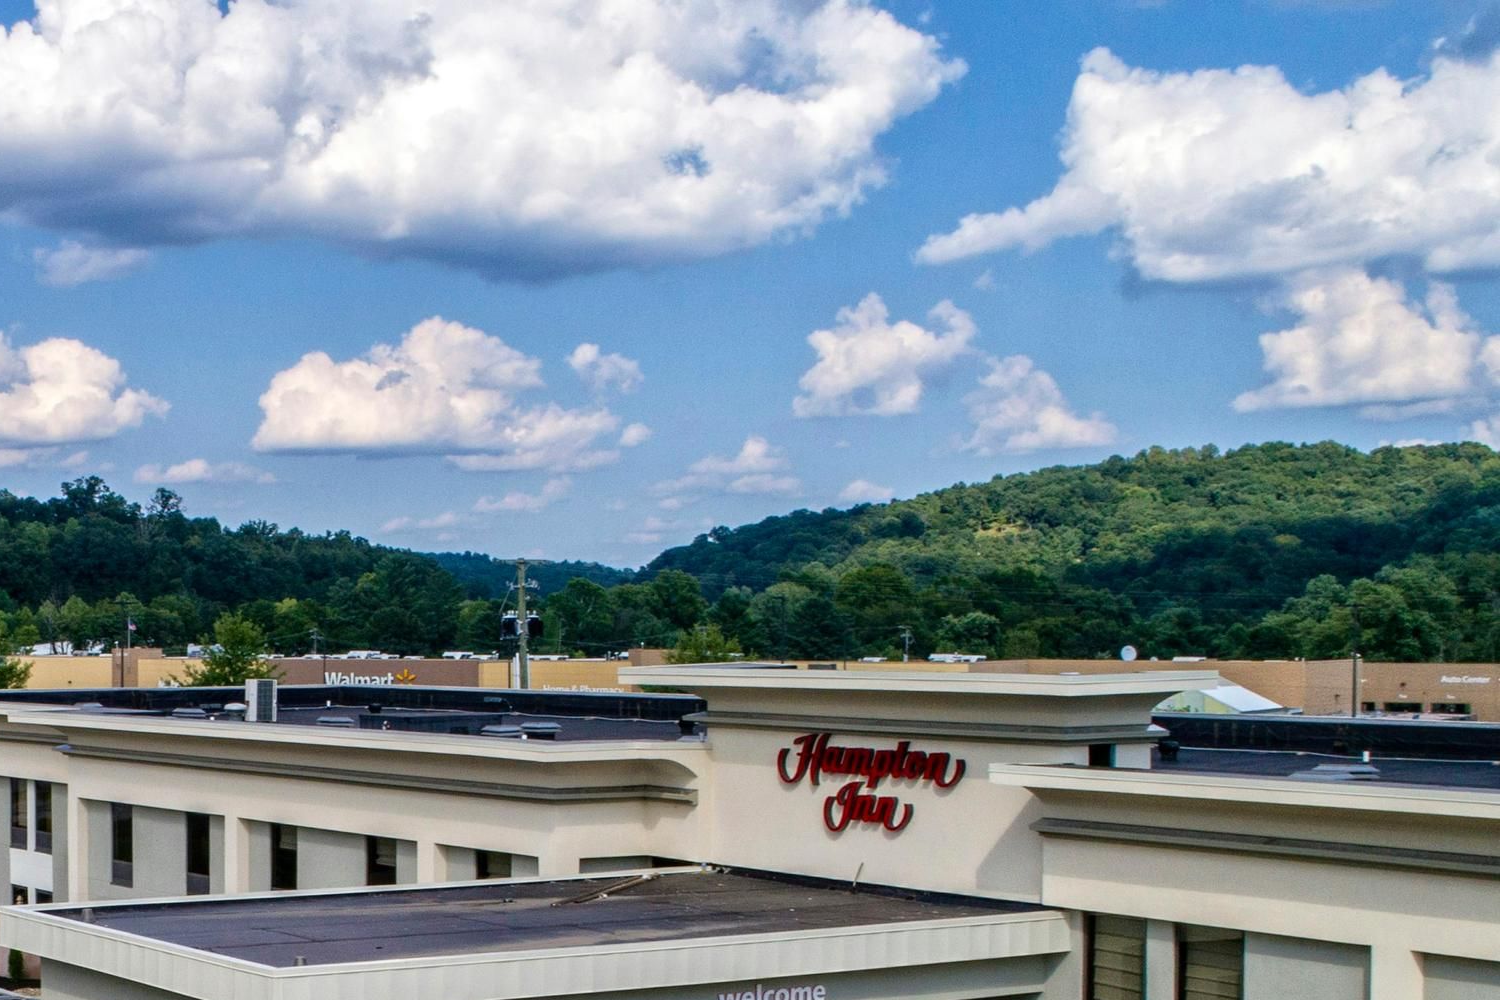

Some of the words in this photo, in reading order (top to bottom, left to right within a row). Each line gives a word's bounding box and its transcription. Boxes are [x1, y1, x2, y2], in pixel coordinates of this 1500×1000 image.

[324, 672, 394, 686] Walmart
[777, 733, 966, 788] Hampton
[823, 781, 913, 832] Inn
